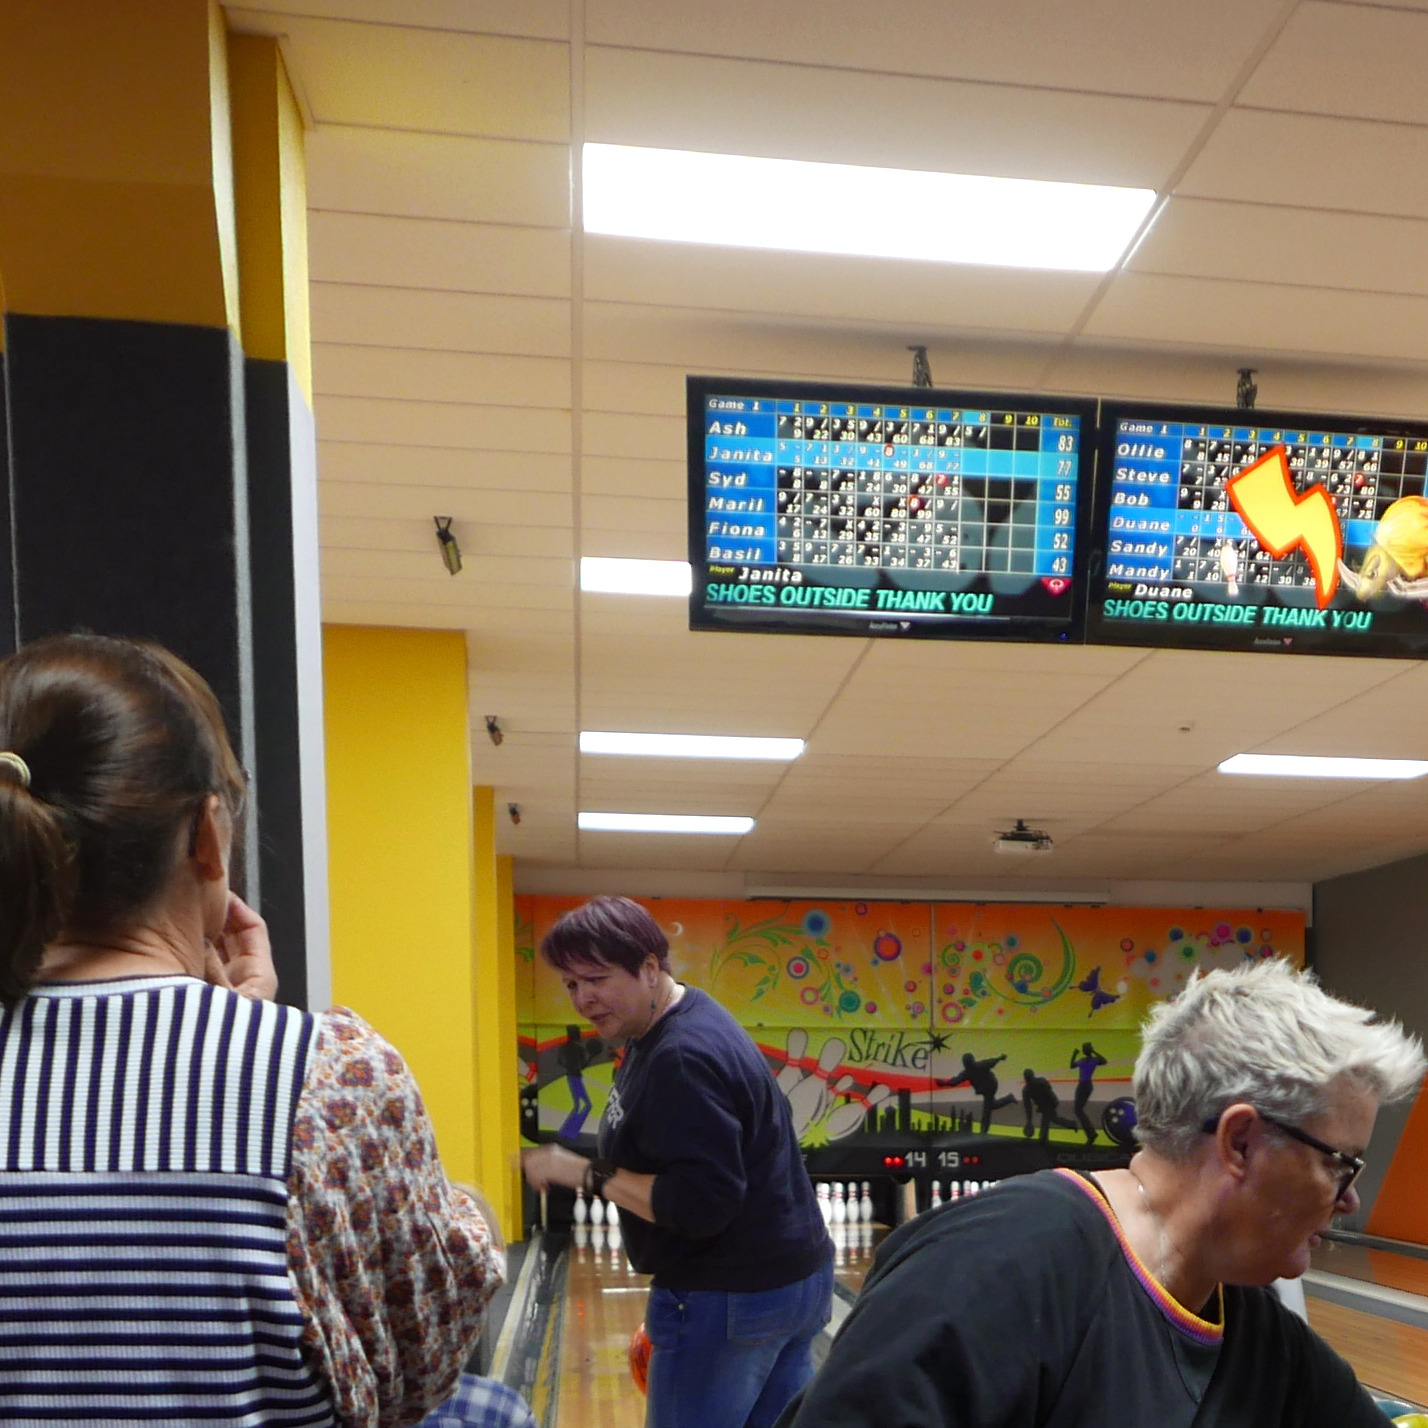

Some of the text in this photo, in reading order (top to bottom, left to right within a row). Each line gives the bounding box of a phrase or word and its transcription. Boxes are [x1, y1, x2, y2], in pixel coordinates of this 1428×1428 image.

[709, 399, 744, 410] Game
[752, 402, 759, 410] 1
[820, 404, 827, 413] 2
[847, 405, 854, 414] 3
[873, 407, 880, 416] 4
[900, 408, 907, 418] 5
[926, 410, 933, 419] 6
[952, 412, 959, 421] 7
[979, 412, 986, 422] 8
[1005, 414, 1012, 424] 9
[1026, 416, 1038, 425] 10
[709, 421, 747, 434] Ash
[813, 430, 828, 439] 22
[867, 432, 881, 442] 43
[919, 435, 934, 444] 68
[1058, 435, 1073, 451] 83
[1120, 422, 1153, 433] Game
[1160, 424, 1168, 434] 1
[1223, 428, 1231, 438] 2
[1249, 430, 1256, 439] 3
[1274, 431, 1280, 440] 4
[1298, 434, 1305, 443] 5
[1396, 440, 1403, 449] 9
[1415, 441, 1427, 450] 10
[709, 447, 773, 462] Janita
[1058, 461, 1072, 475] 77
[1118, 443, 1164, 458] Ollie
[1216, 453, 1230, 462] 15
[1241, 454, 1255, 463] 19
[1315, 459, 1328, 468] 39
[1339, 461, 1352, 469] 57
[709, 472, 746, 488] Syd
[840, 481, 854, 491] 15
[866, 482, 881, 492] 24
[893, 484, 907, 493] 30
[919, 486, 933, 494] 47
[945, 487, 958, 496] 55
[1056, 485, 1071, 501] 55
[1116, 468, 1170, 483] Steve
[1337, 485, 1350, 494] 73
[1361, 486, 1374, 495] 80
[709, 498, 763, 511] Maril
[787, 504, 801, 513] 17
[813, 505, 827, 514] 24
[839, 506, 853, 515] 32
[865, 507, 880, 516] 60
[917, 510, 932, 519] 99
[1055, 509, 1069, 524] 99
[1114, 492, 1372, 519] Bob 9 28 75
[709, 522, 765, 536] Fiona
[813, 530, 827, 538] 13
[865, 532, 879, 541] 35
[917, 534, 932, 543] 47
[942, 536, 957, 545] 52
[1054, 533, 1068, 549] 52
[1113, 516, 1170, 531] Duane
[709, 547, 760, 560] Basil
[812, 554, 827, 563] 17
[838, 555, 852, 564] 26
[864, 557, 879, 565] 33
[891, 557, 905, 566] 34
[917, 558, 931, 568] 37
[942, 559, 957, 569] 43
[1052, 558, 1067, 572] 43
[1111, 541, 1269, 560] Sandy 20 62
[709, 565, 802, 581] Player Janita
[1109, 564, 1292, 585] Mandy 10 12 30
[707, 584, 995, 613] SHOES OUTSIDE THANK YOU
[1135, 583, 1192, 598] Duane
[1104, 599, 1373, 629] SHOES OUTSIDE THANK YOU
[847, 1028, 930, 1071] Strike
[904, 1151, 960, 1168] 14 15
